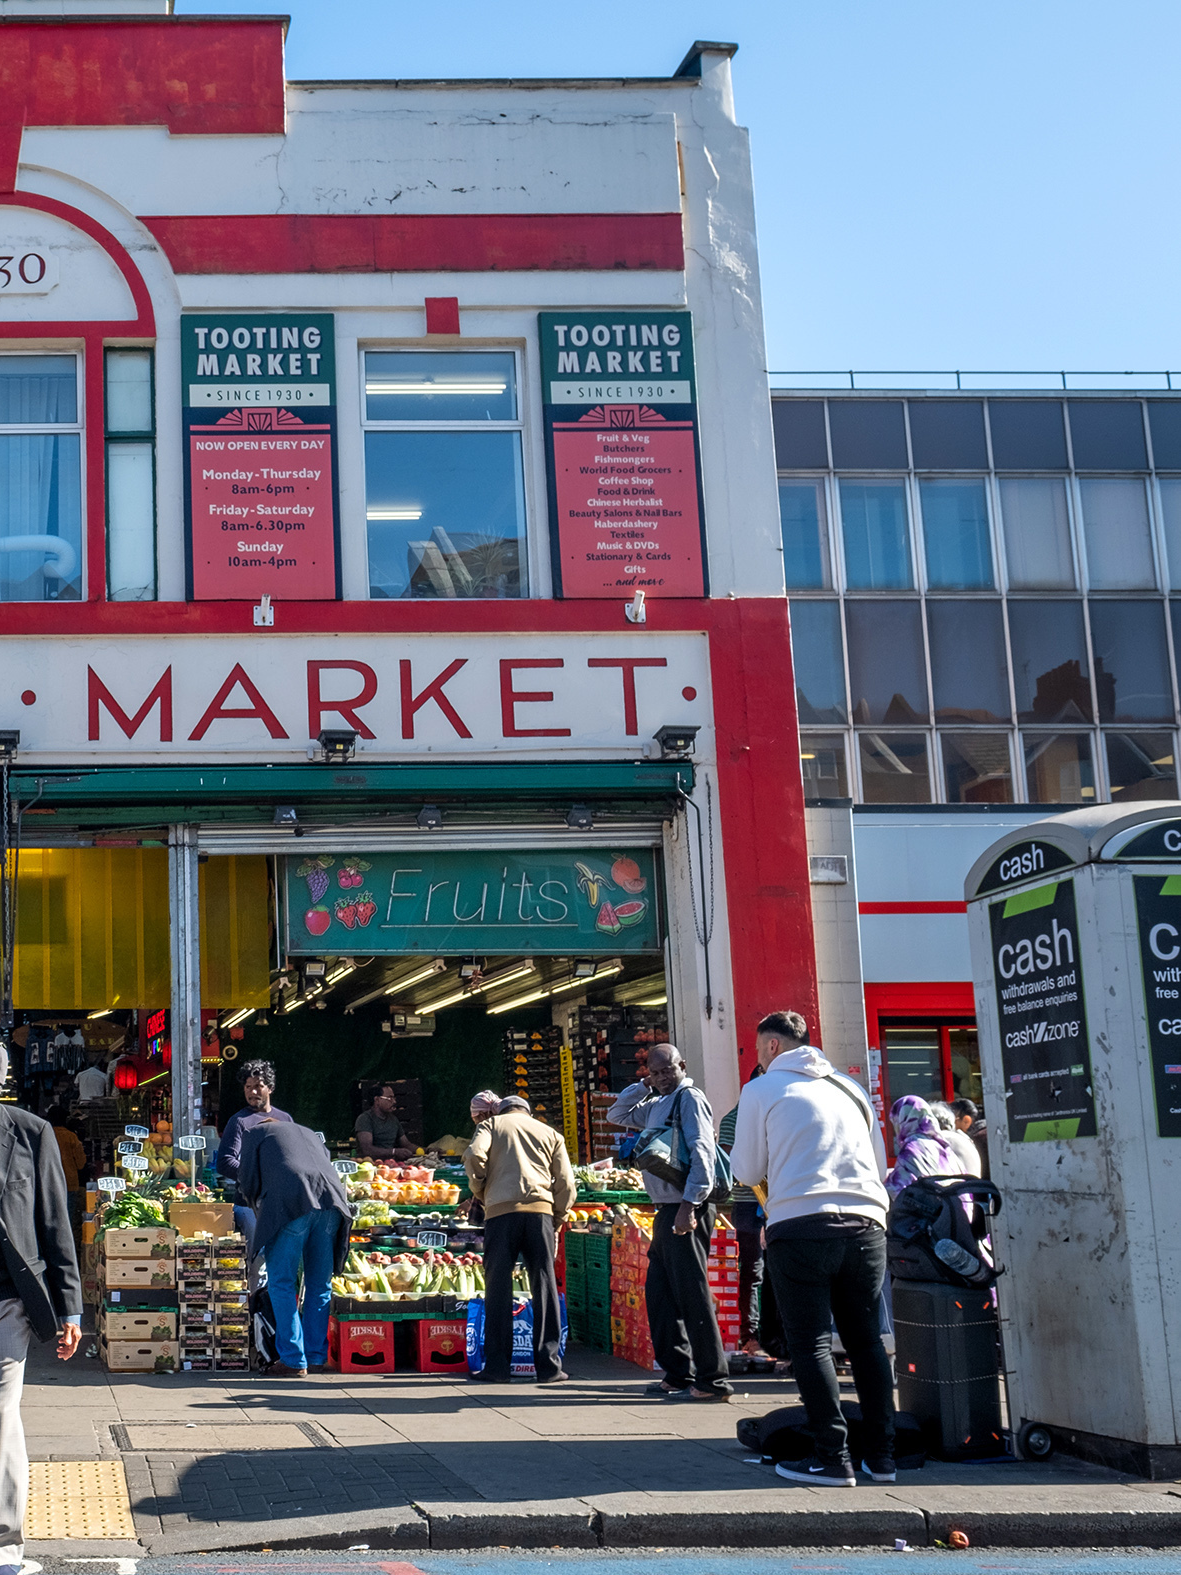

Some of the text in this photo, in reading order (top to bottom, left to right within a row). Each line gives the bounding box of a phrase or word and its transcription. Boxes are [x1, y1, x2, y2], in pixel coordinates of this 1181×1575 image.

[195, 327, 321, 349] TOOTING
[554, 325, 680, 346] TOOTING
[197, 354, 321, 375] MARKET
[558, 351, 680, 373] MARKET
[218, 390, 301, 400] SINCE 1930
[579, 387, 663, 397] SINCE 1930
[597, 434, 619, 442] Fruit
[632, 435, 649, 444] Veg
[196, 441, 324, 450] NOW OPEN EVERY DAY
[595, 456, 654, 465] Fishmongers
[580, 466, 671, 474] World Food Grocers
[599, 477, 653, 486] Coffee Shop
[232, 484, 294, 496] 8am-6pm
[569, 510, 601, 518] Beauty
[221, 520, 305, 533] 8am-6.30pm
[594, 520, 658, 529] Haberdashery
[237, 541, 283, 554] Sunday
[597, 542, 622, 550] Music
[228, 557, 297, 569] 10am-4pm
[586, 553, 633, 562] Stationary
[616, 576, 636, 586] and
[638, 578, 665, 586] more
[87, 658, 668, 742] MARKET
[1000, 844, 1044, 881] cash
[387, 867, 568, 922] Fruits
[999, 919, 1074, 979] cash
[1001, 970, 1076, 1000] withdrawals and
[1156, 988, 1179, 998] free
[1003, 992, 1077, 1015] free balance enquiries
[350, 1325, 384, 1337] TYSKIE
[430, 1325, 465, 1336] TYSKIE
